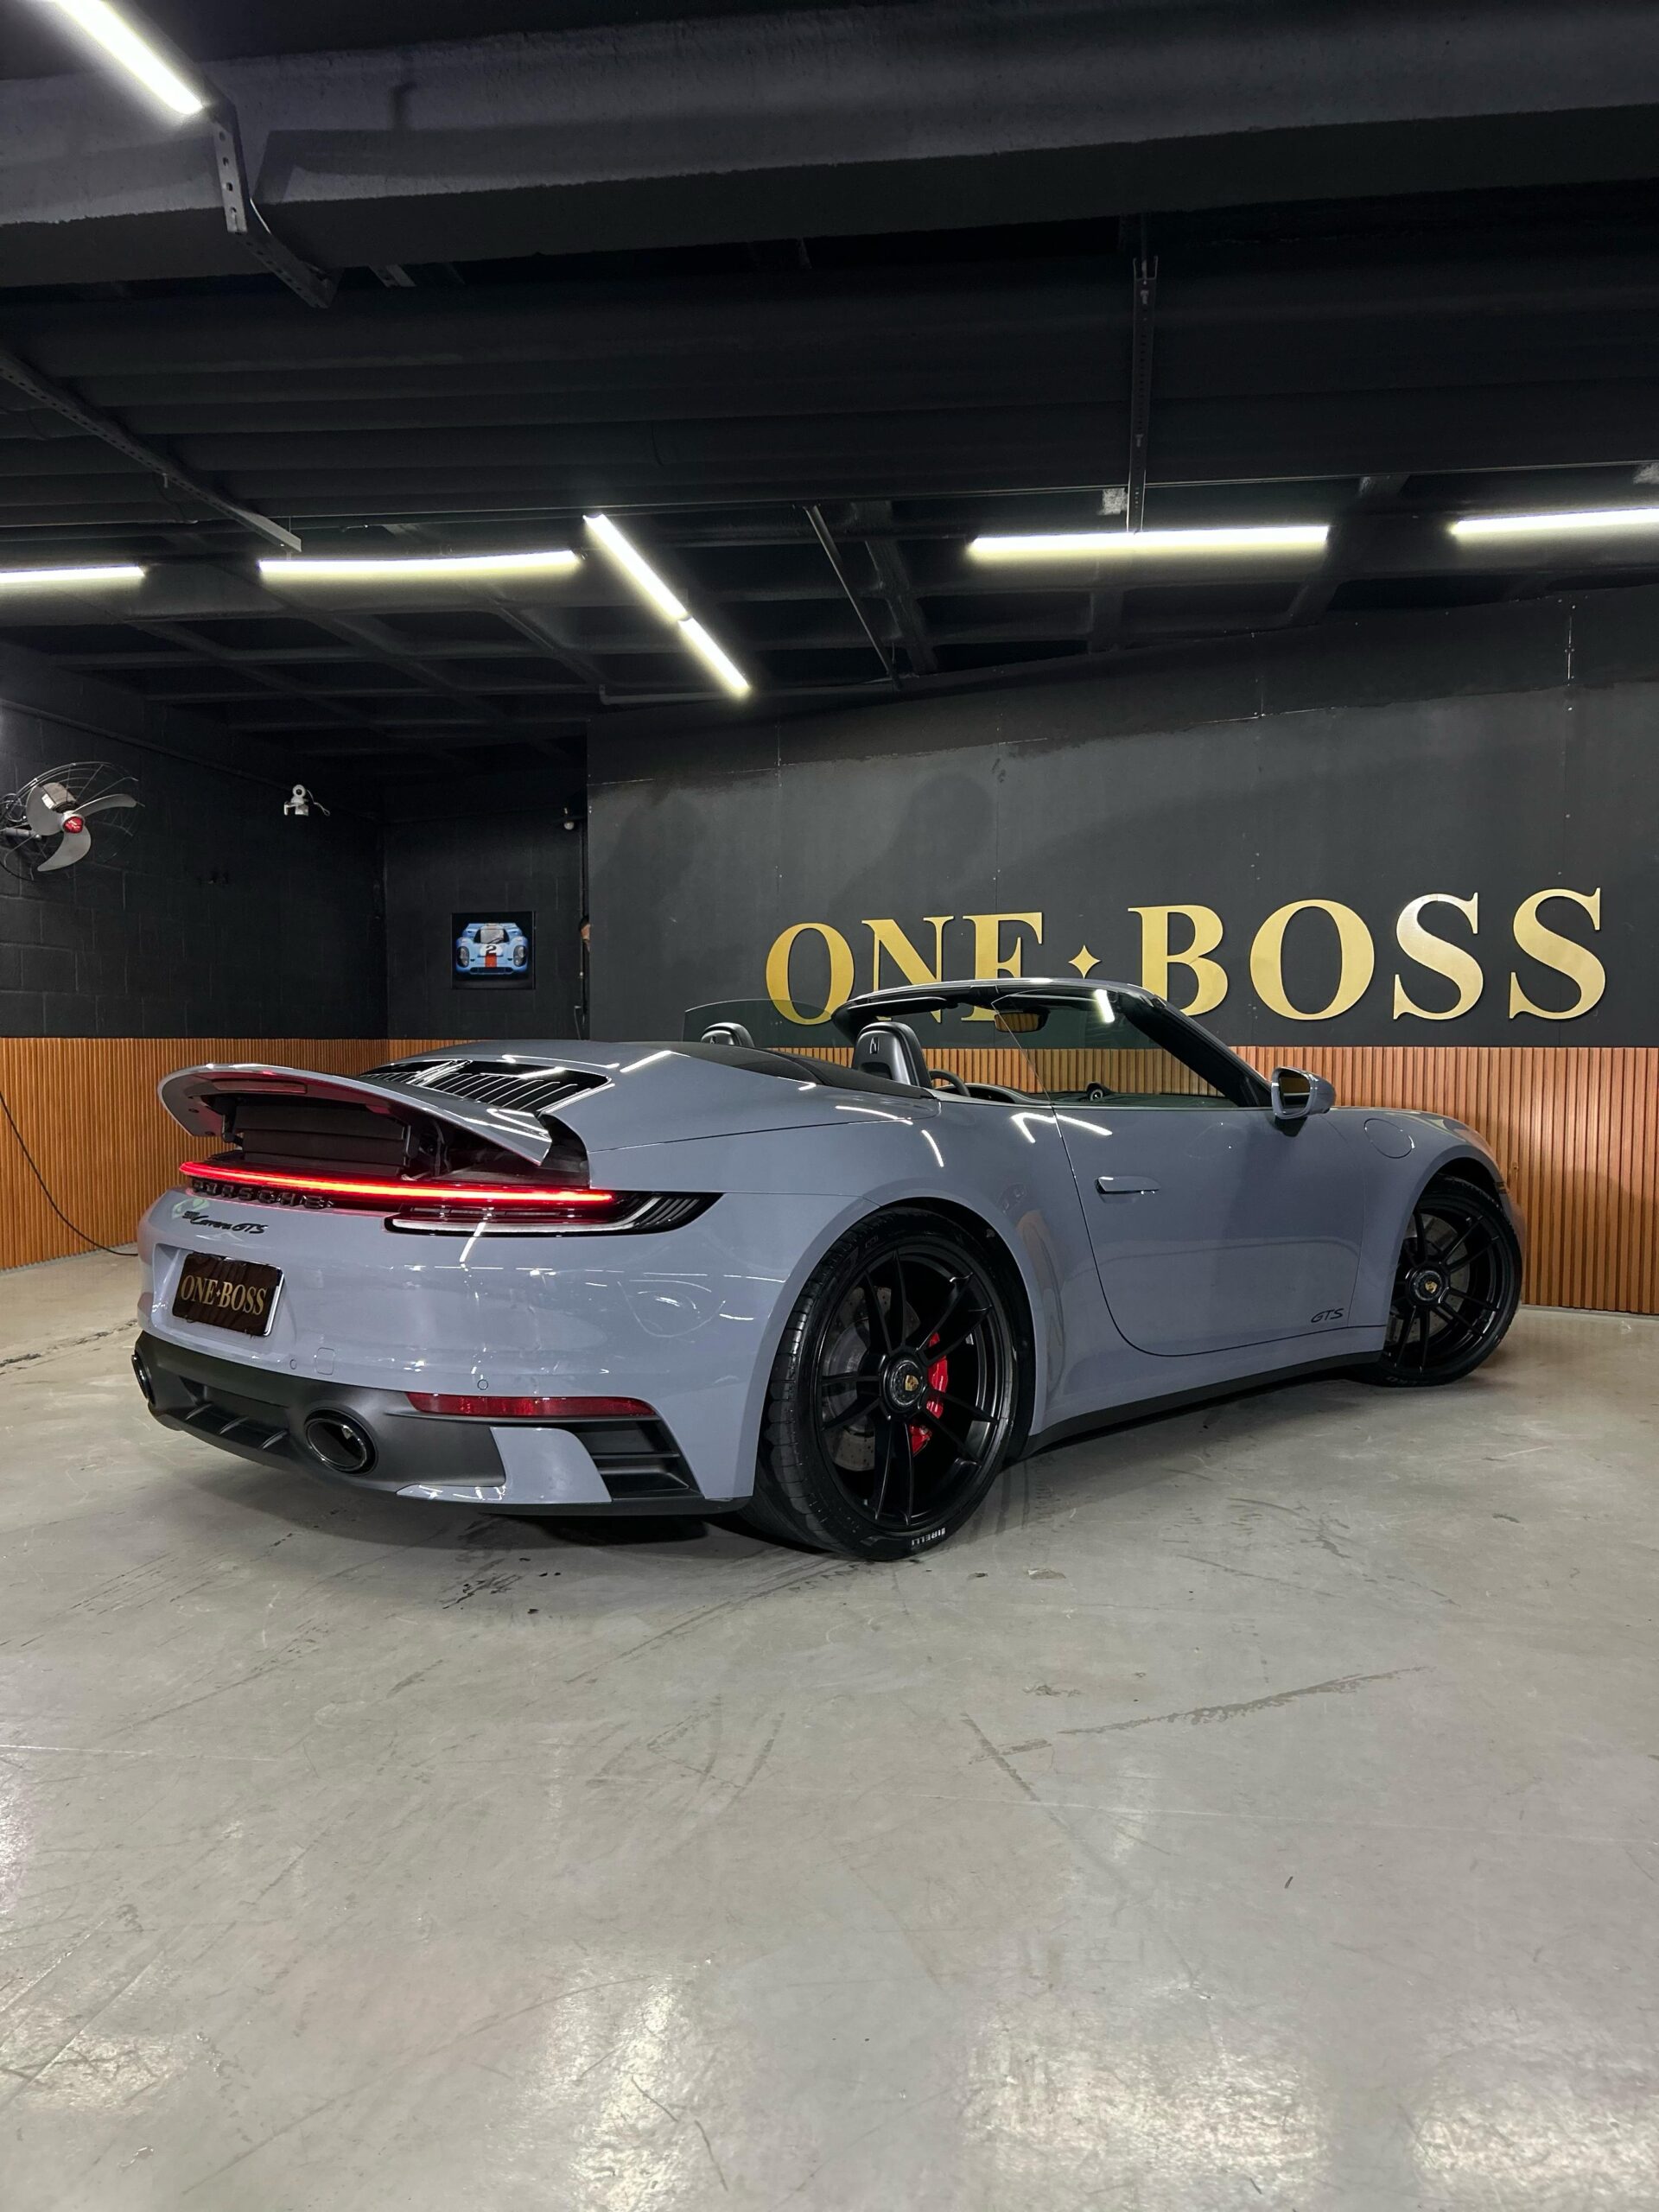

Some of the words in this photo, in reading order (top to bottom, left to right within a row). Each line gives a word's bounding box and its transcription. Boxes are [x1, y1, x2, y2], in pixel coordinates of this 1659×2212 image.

[486, 944, 497, 955] 2
[766, 912, 1043, 1026] ONE
[1128, 887, 1606, 1021] BOSS
[232, 1223, 269, 1234] GTS
[180, 1274, 219, 1306] ONE
[218, 1281, 268, 1316] BOSS
[1311, 1308, 1344, 1323] GTS
